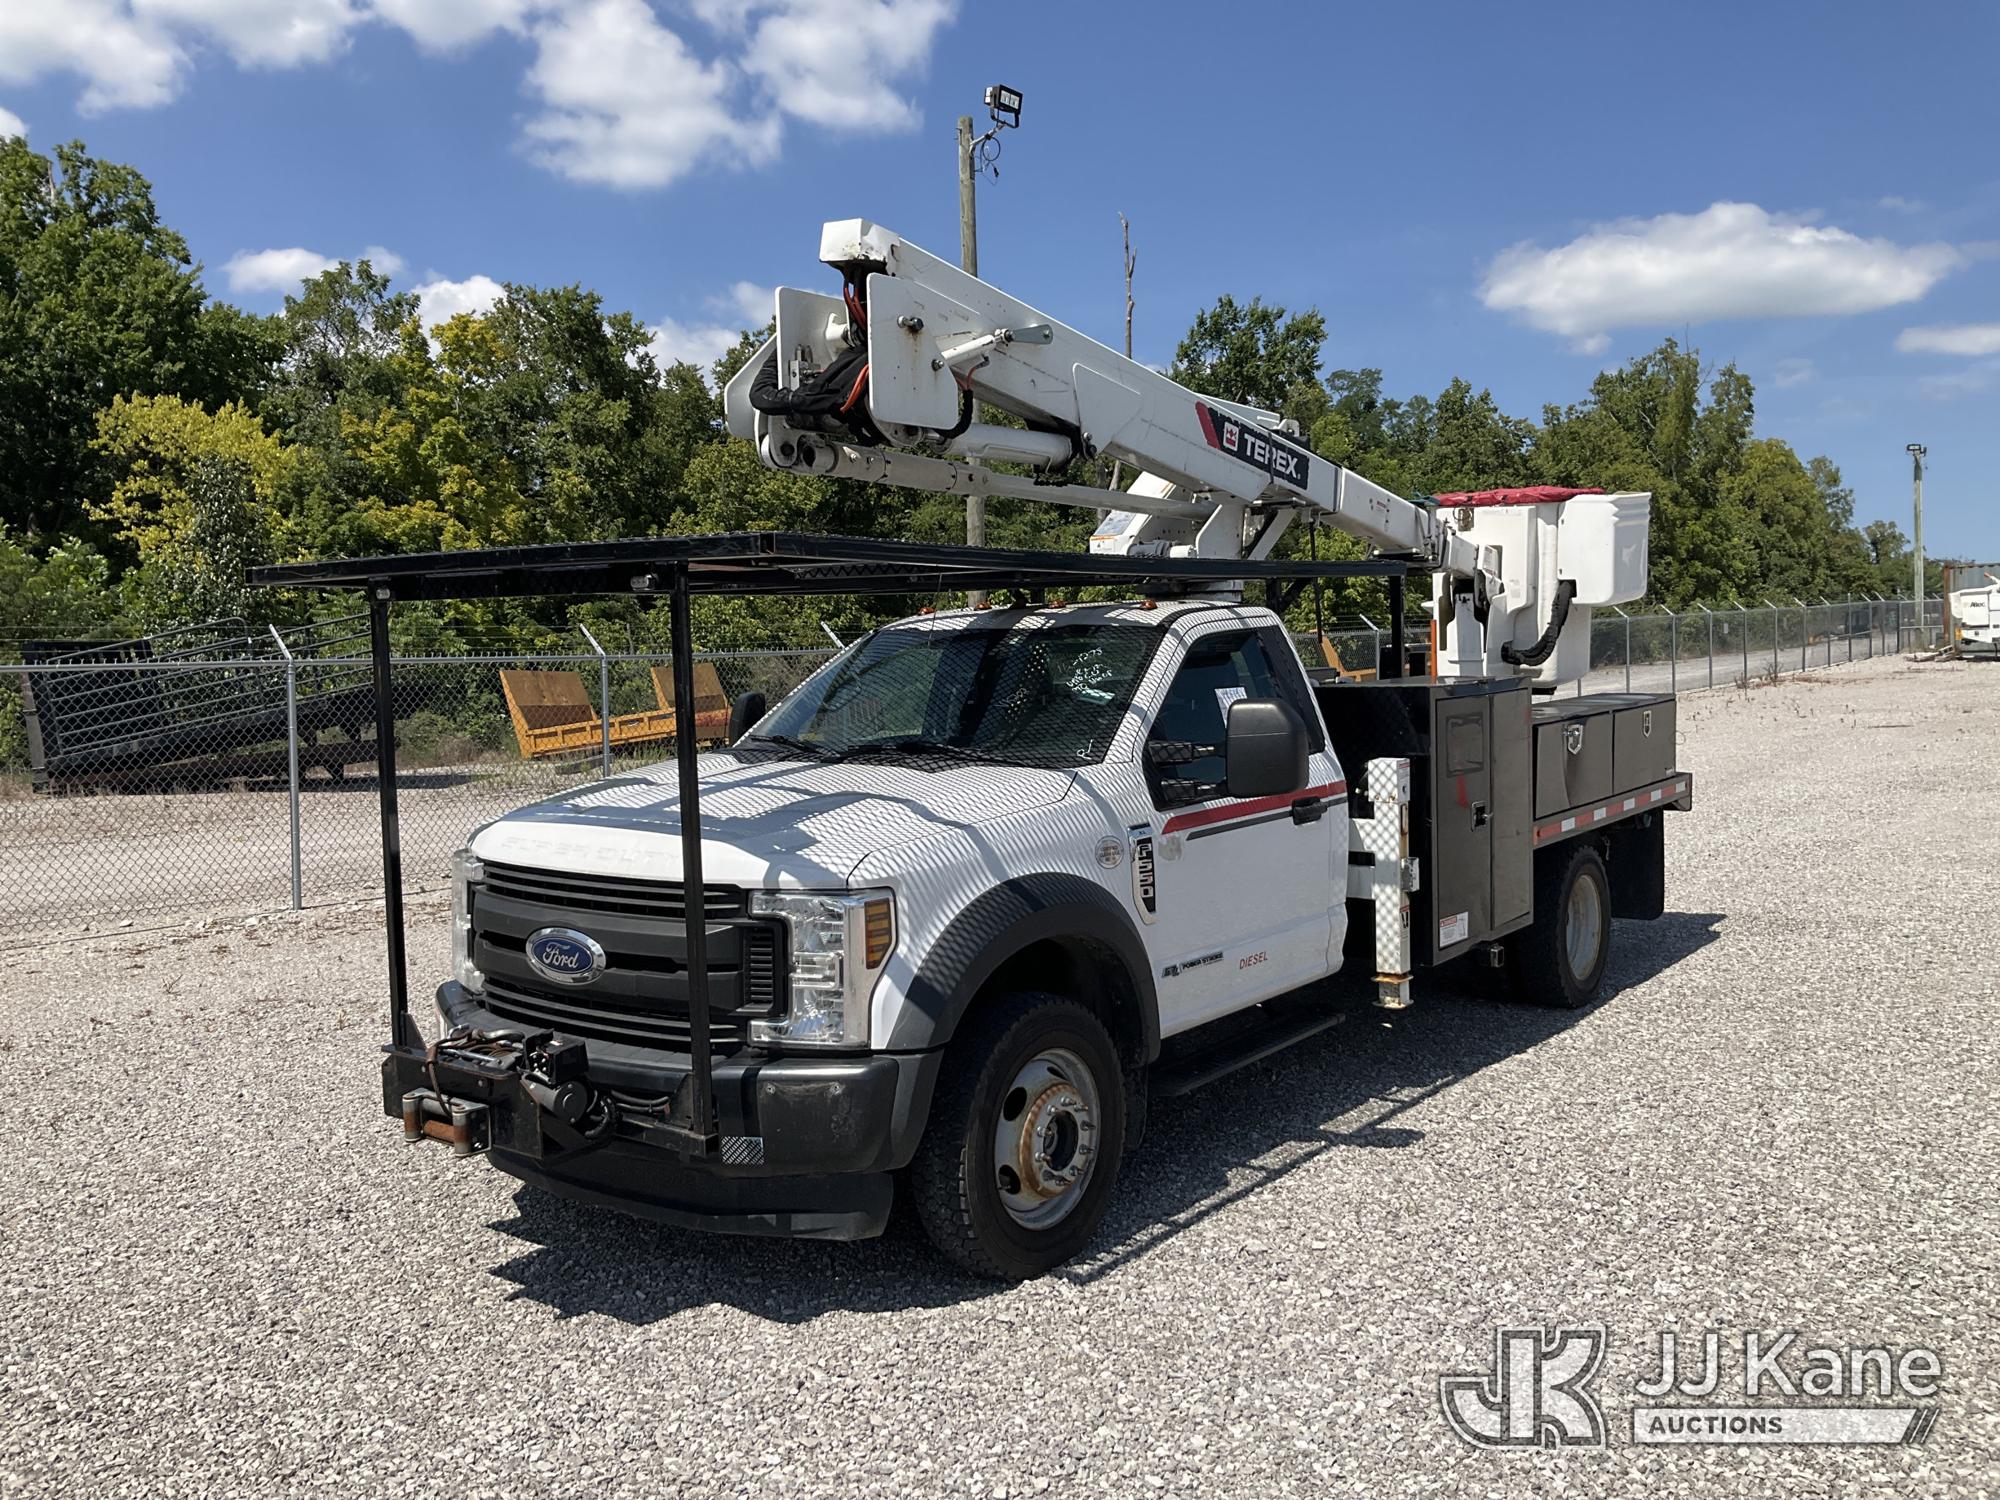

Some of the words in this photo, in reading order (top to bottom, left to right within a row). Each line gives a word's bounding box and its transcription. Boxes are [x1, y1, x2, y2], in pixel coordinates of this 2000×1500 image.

[1243, 433, 1299, 478] TEREX
[501, 836, 592, 860] SUPER
[597, 846, 682, 870] DUTY
[542, 941, 579, 968] Ford
[1239, 951, 1269, 970] DIESEL
